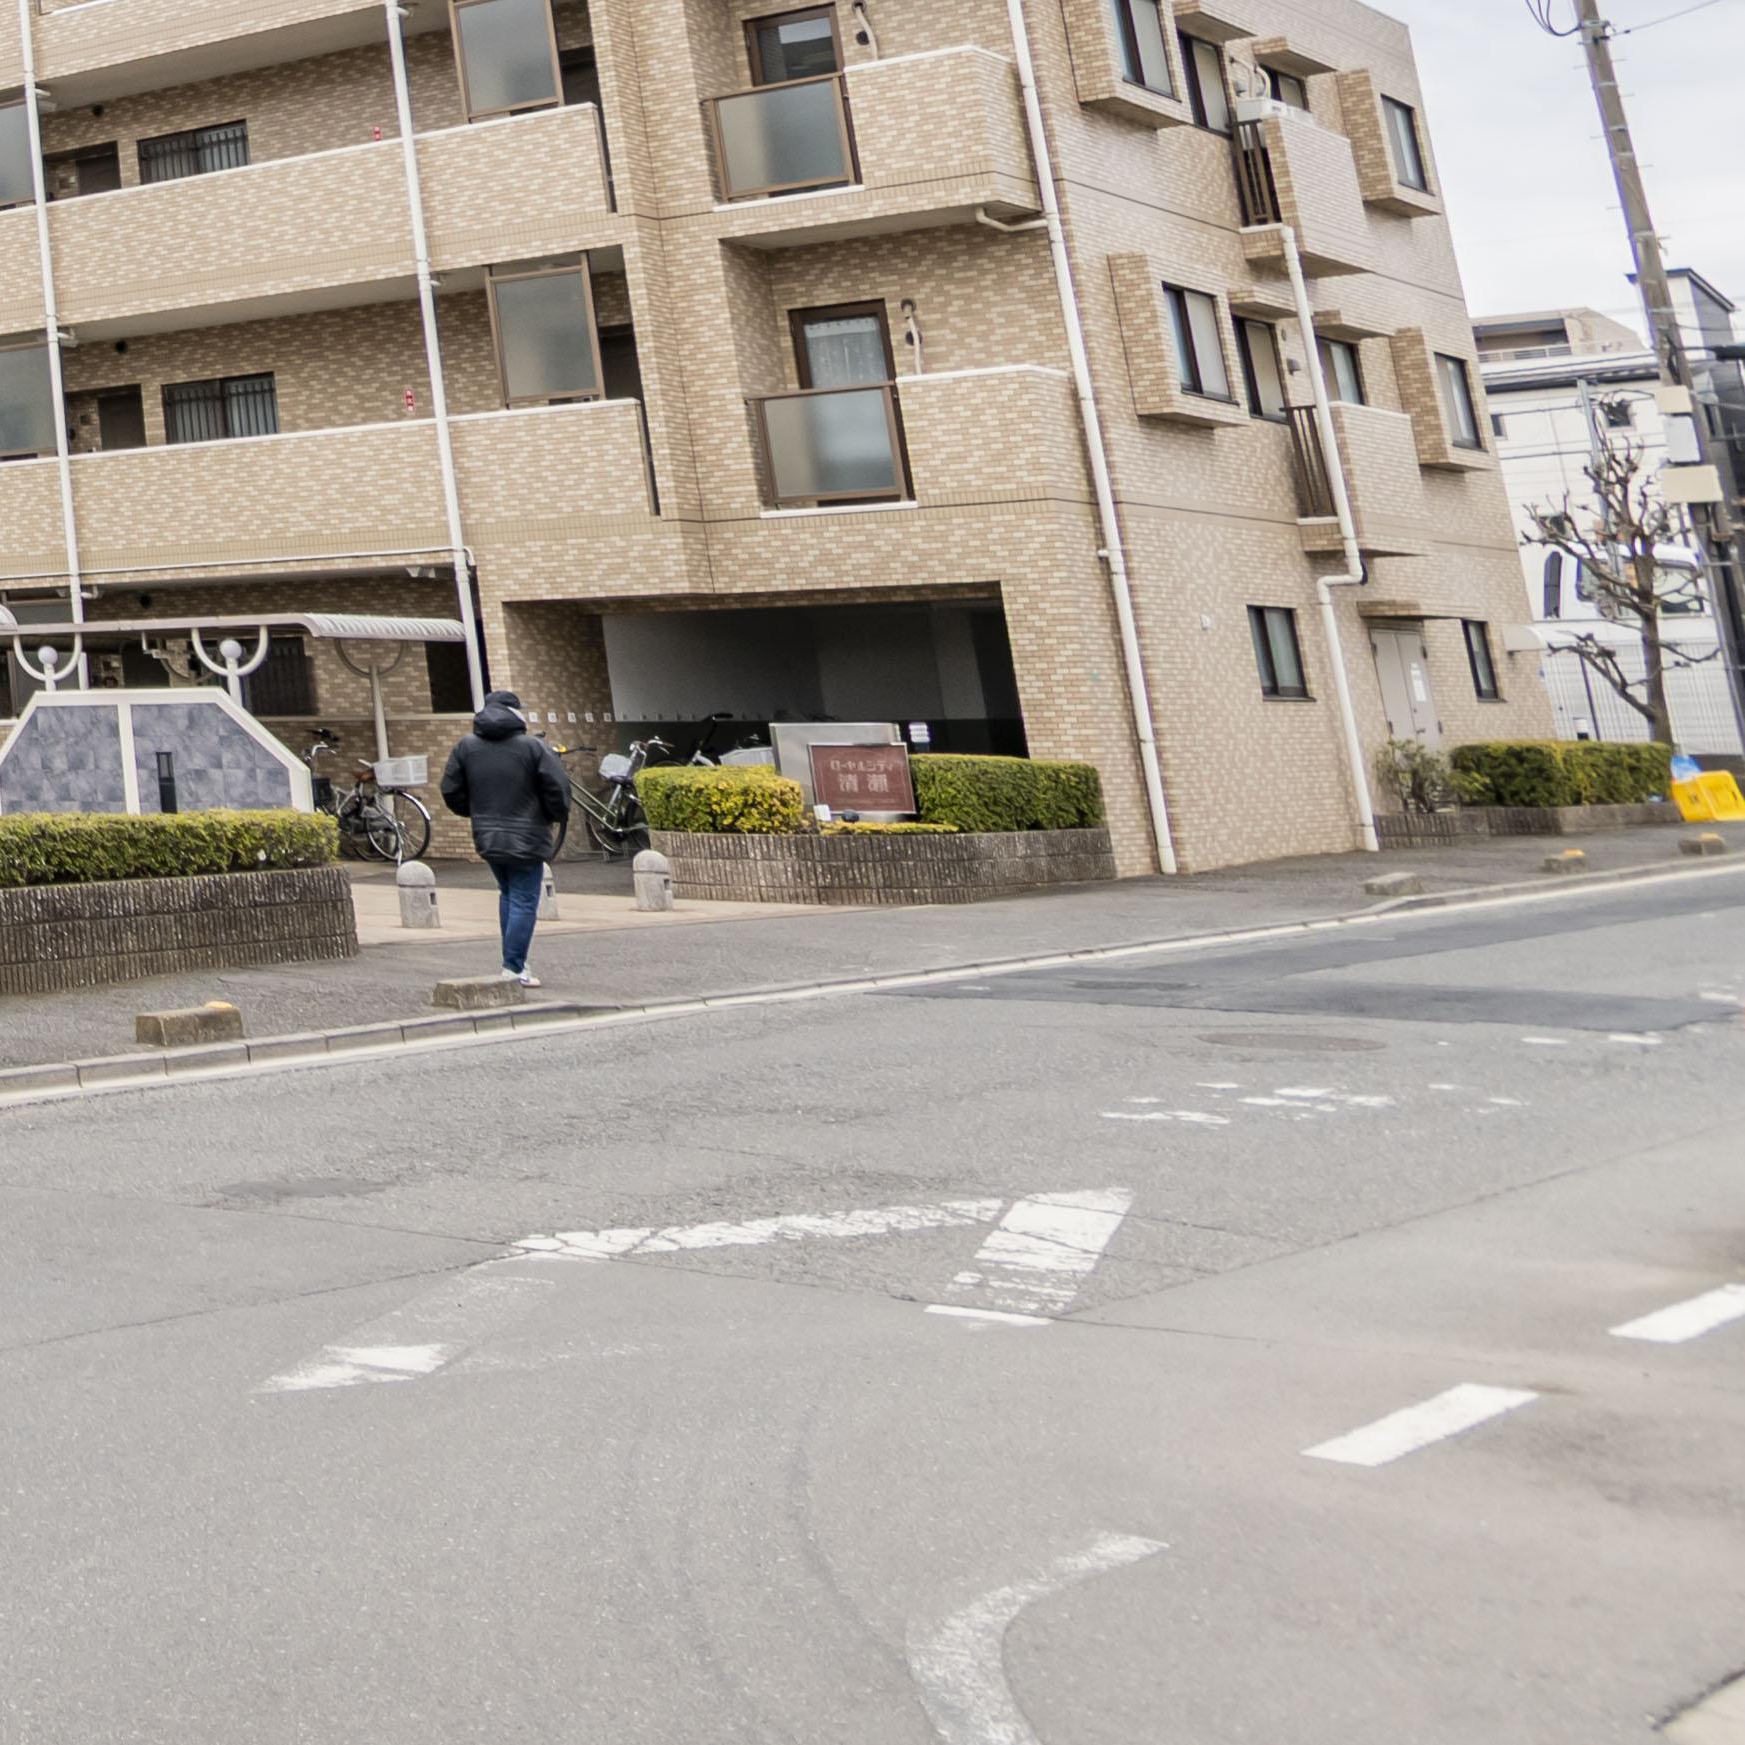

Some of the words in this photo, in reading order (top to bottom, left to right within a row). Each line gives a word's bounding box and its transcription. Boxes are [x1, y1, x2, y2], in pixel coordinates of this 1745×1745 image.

[829, 759, 896, 772] ローヤルシティ
[838, 773, 890, 793] 清瀬
